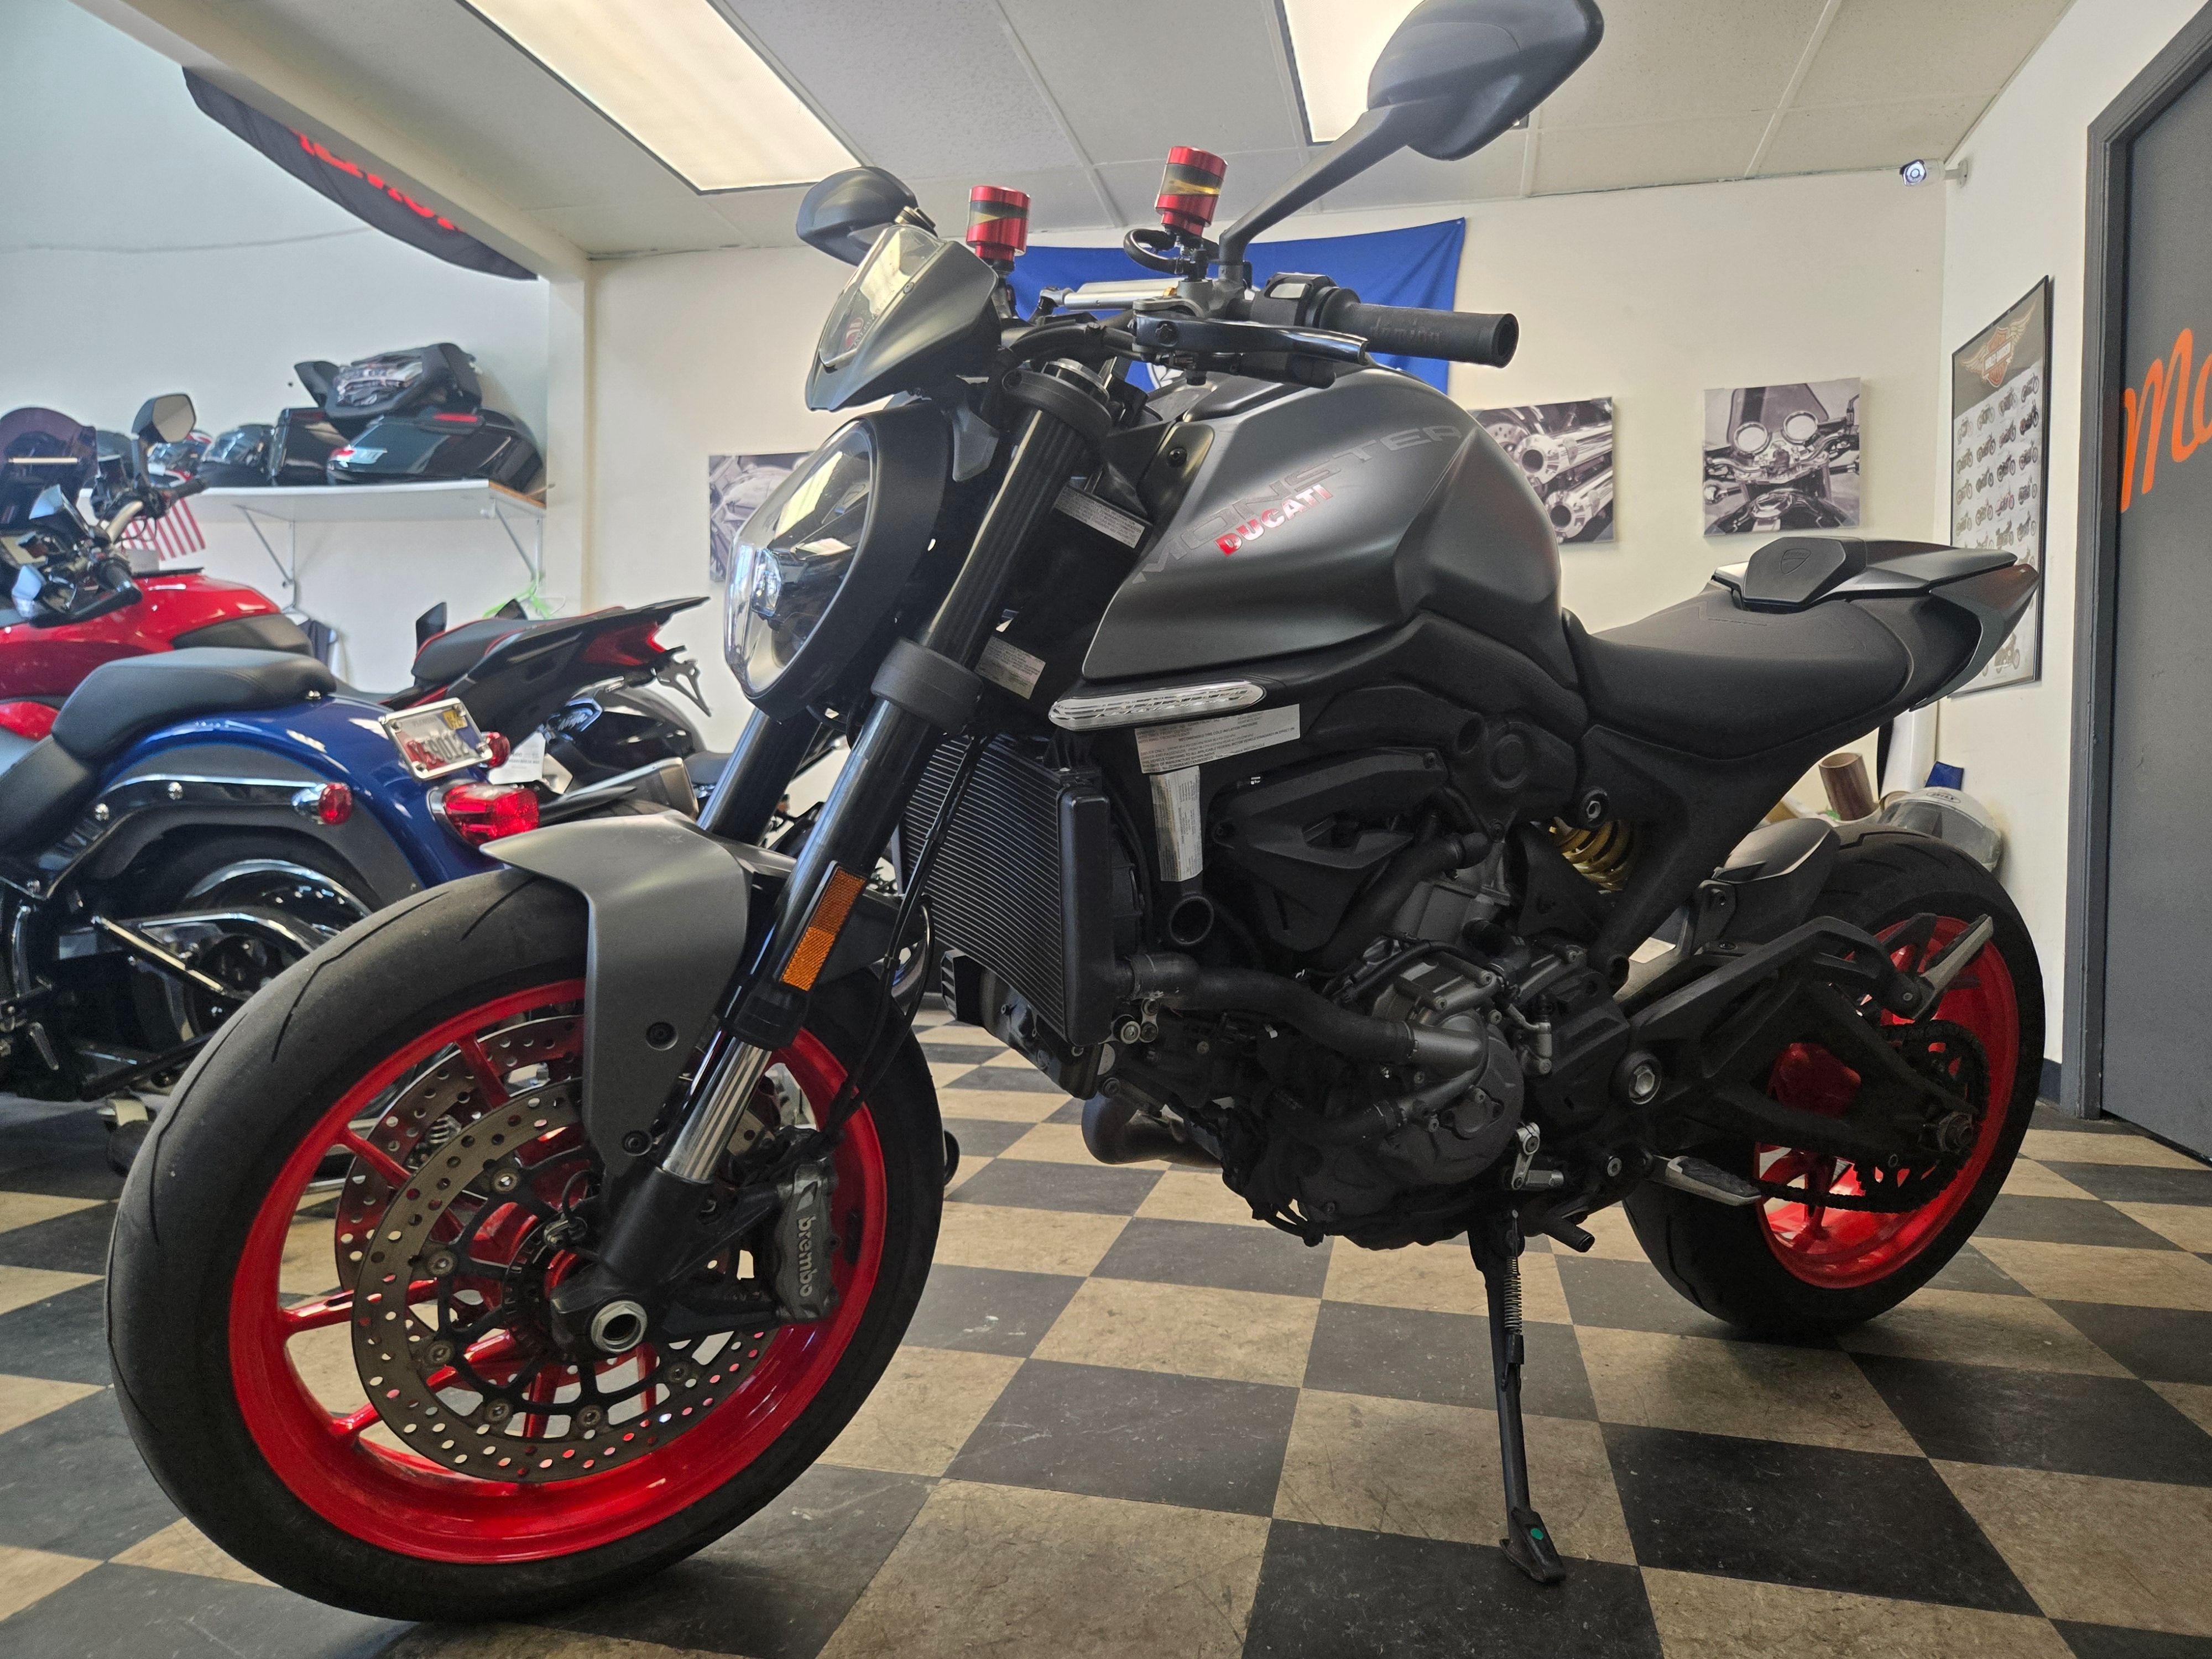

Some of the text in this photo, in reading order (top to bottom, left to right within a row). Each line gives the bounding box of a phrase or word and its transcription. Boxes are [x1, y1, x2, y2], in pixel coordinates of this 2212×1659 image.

[1133, 425, 1462, 583] MONSTER
[1215, 484, 1333, 555] DUCATI
[797, 1216, 816, 1297] brembo
